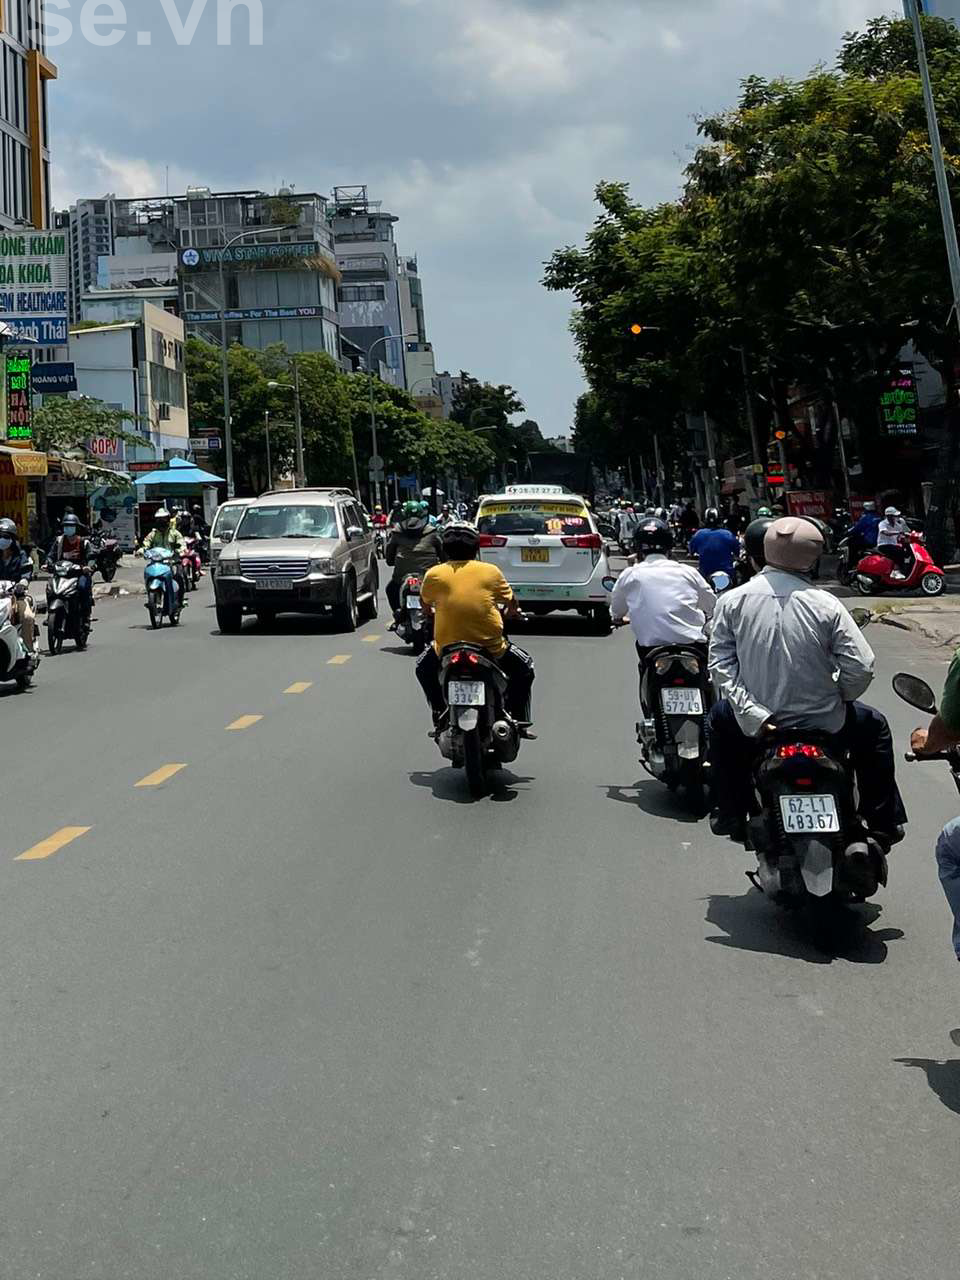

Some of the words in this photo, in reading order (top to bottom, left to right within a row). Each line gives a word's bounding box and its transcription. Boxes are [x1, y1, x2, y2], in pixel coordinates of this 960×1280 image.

[29, 232, 65, 256] KHÁM
[234, 246, 266, 261] STAR
[270, 244, 315, 258] COFFEE
[18, 263, 51, 283] KHOA
[16, 290, 66, 312] HEALTHCARE
[298, 307, 316, 316] YOU
[41, 320, 66, 340] Thái
[91, 438, 118, 455] COPY
